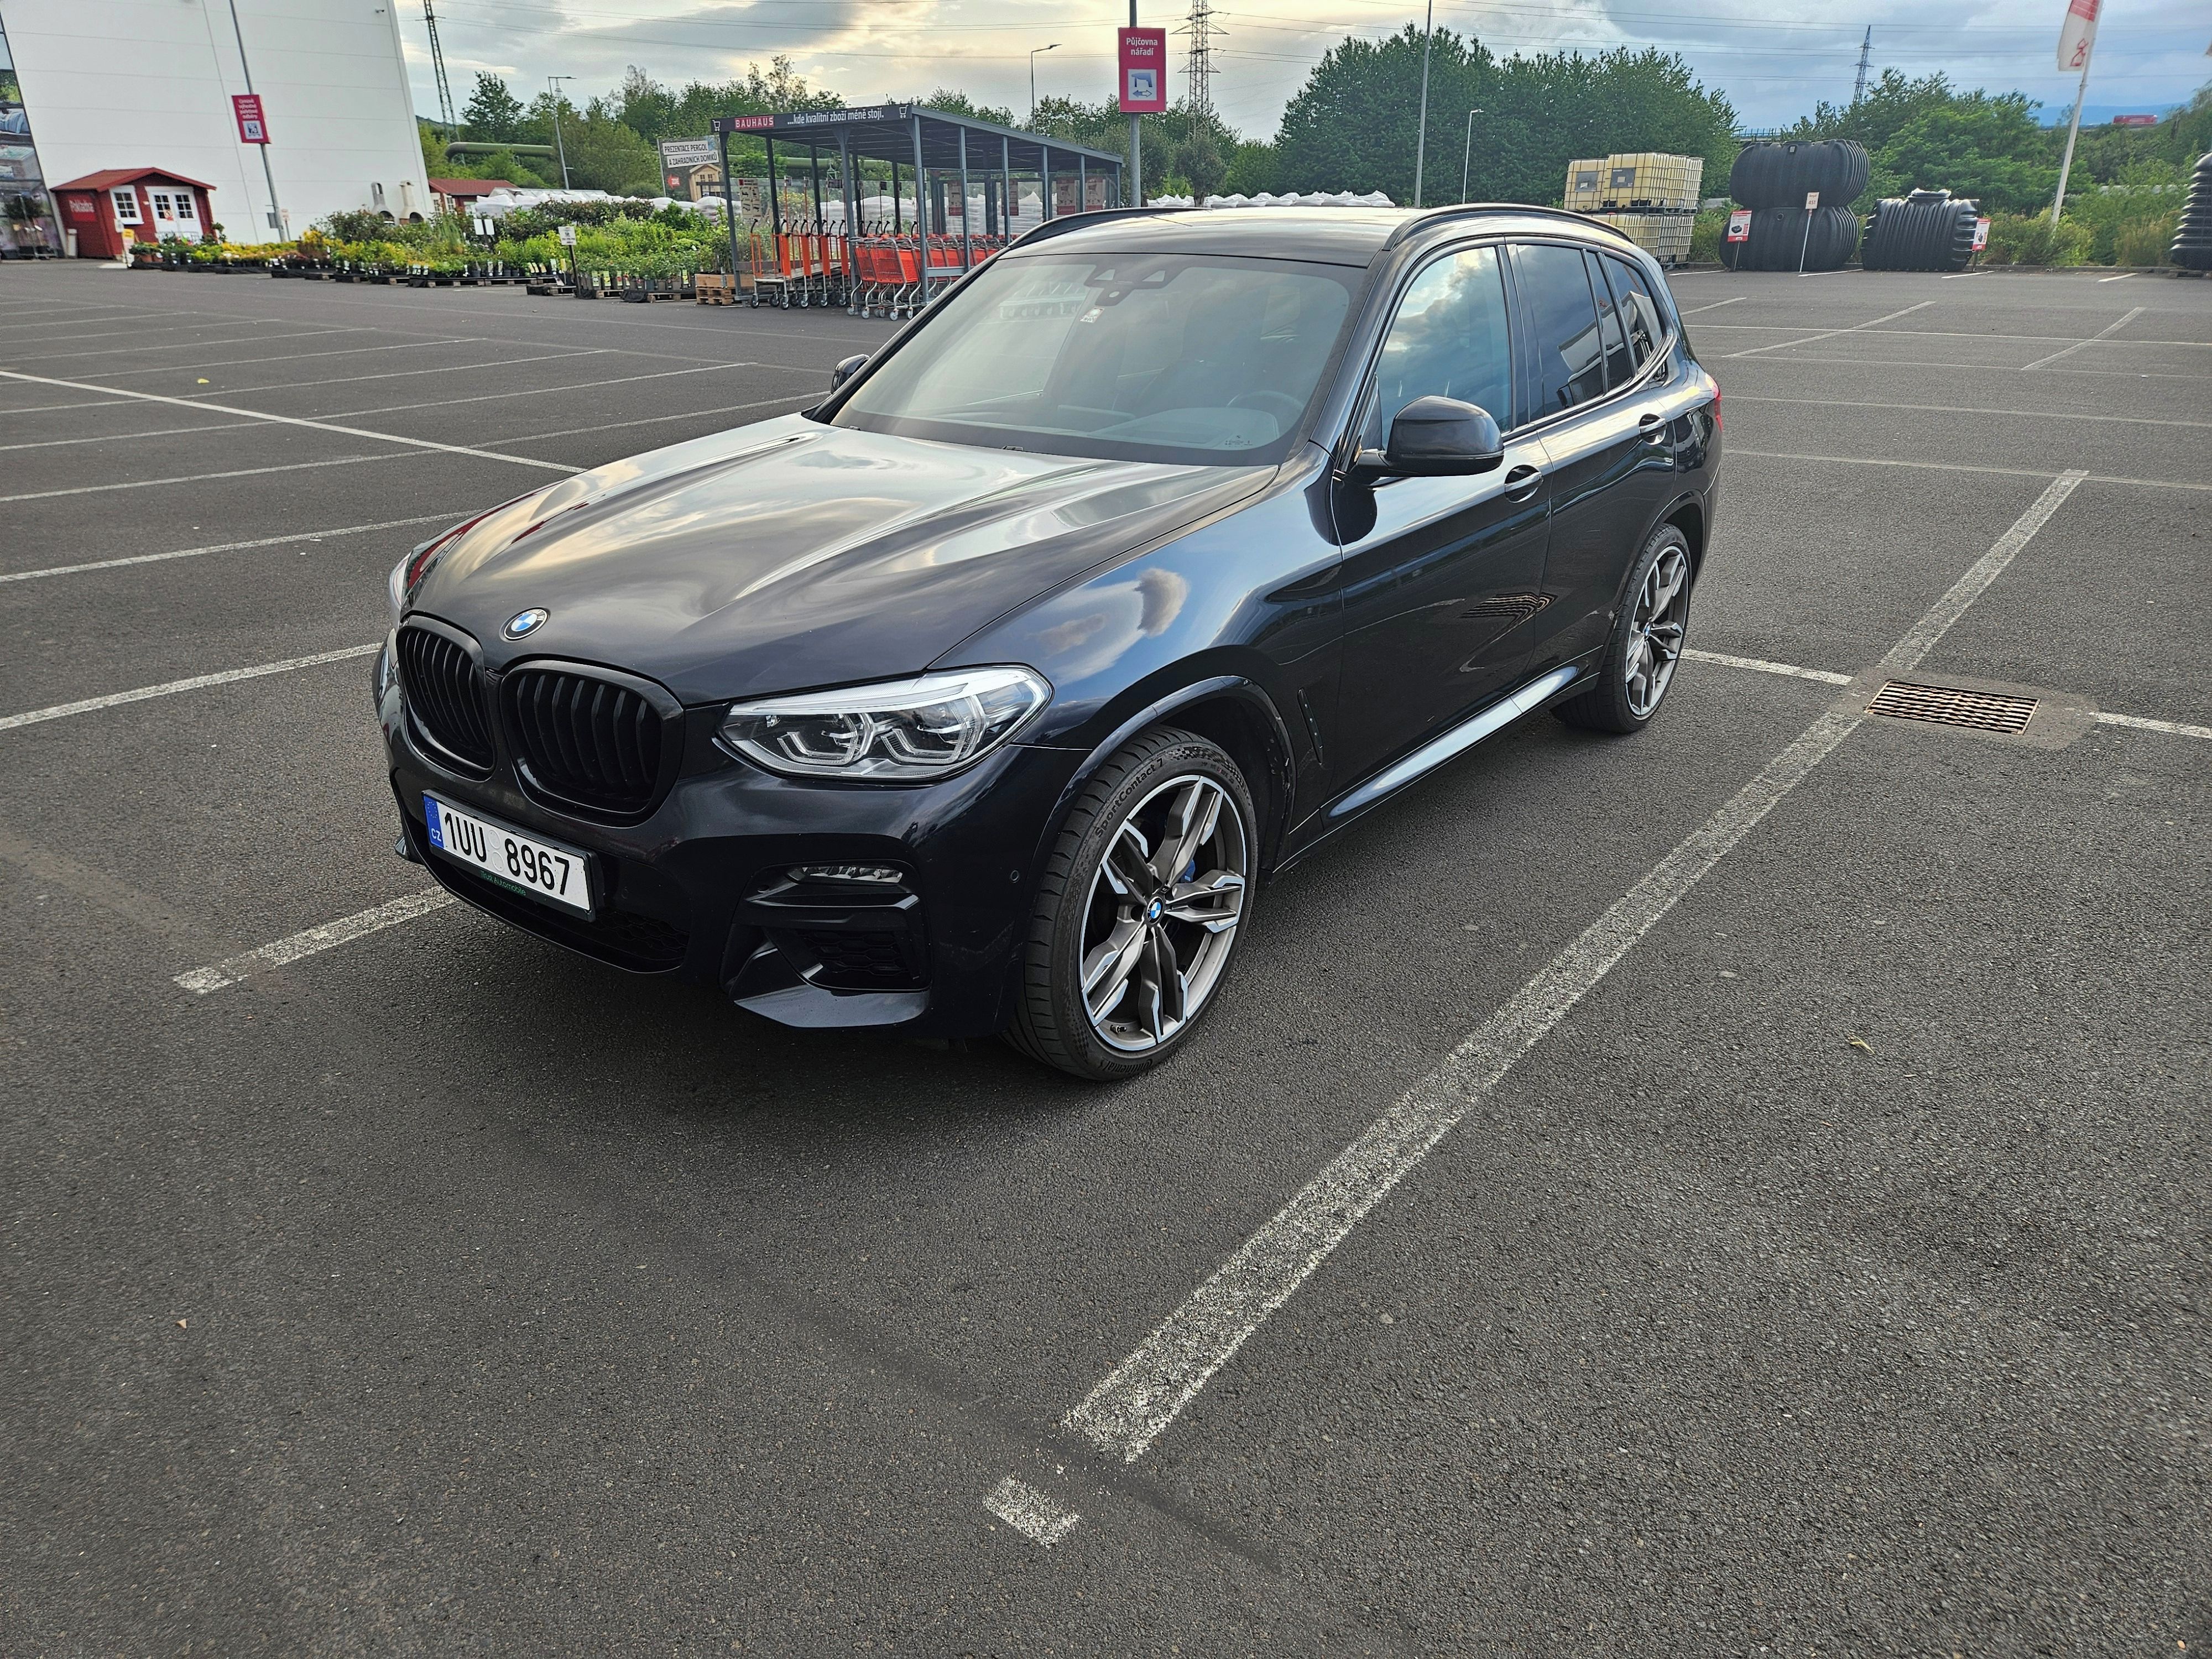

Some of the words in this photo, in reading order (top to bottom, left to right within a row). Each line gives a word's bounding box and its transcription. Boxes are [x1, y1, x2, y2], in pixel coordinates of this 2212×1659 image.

[1126, 37, 1158, 46] Půjčovna
[1131, 48, 1154, 56] nářadí
[806, 112, 828, 123] kvalitní
[830, 111, 847, 122] zboží
[848, 109, 866, 120] méně
[868, 107, 884, 120] stojí.
[735, 117, 774, 128] BAUHAUS
[672, 155, 700, 165] ZAHRADNÍCH
[701, 152, 717, 162] DOMKŮ
[1095, 764, 1156, 838] SportContact
[1157, 758, 1164, 768] 7
[431, 828, 442, 842] CZ
[445, 812, 487, 863] 1UU
[505, 838, 569, 895] 8967
[494, 877, 526, 896] Automobile
